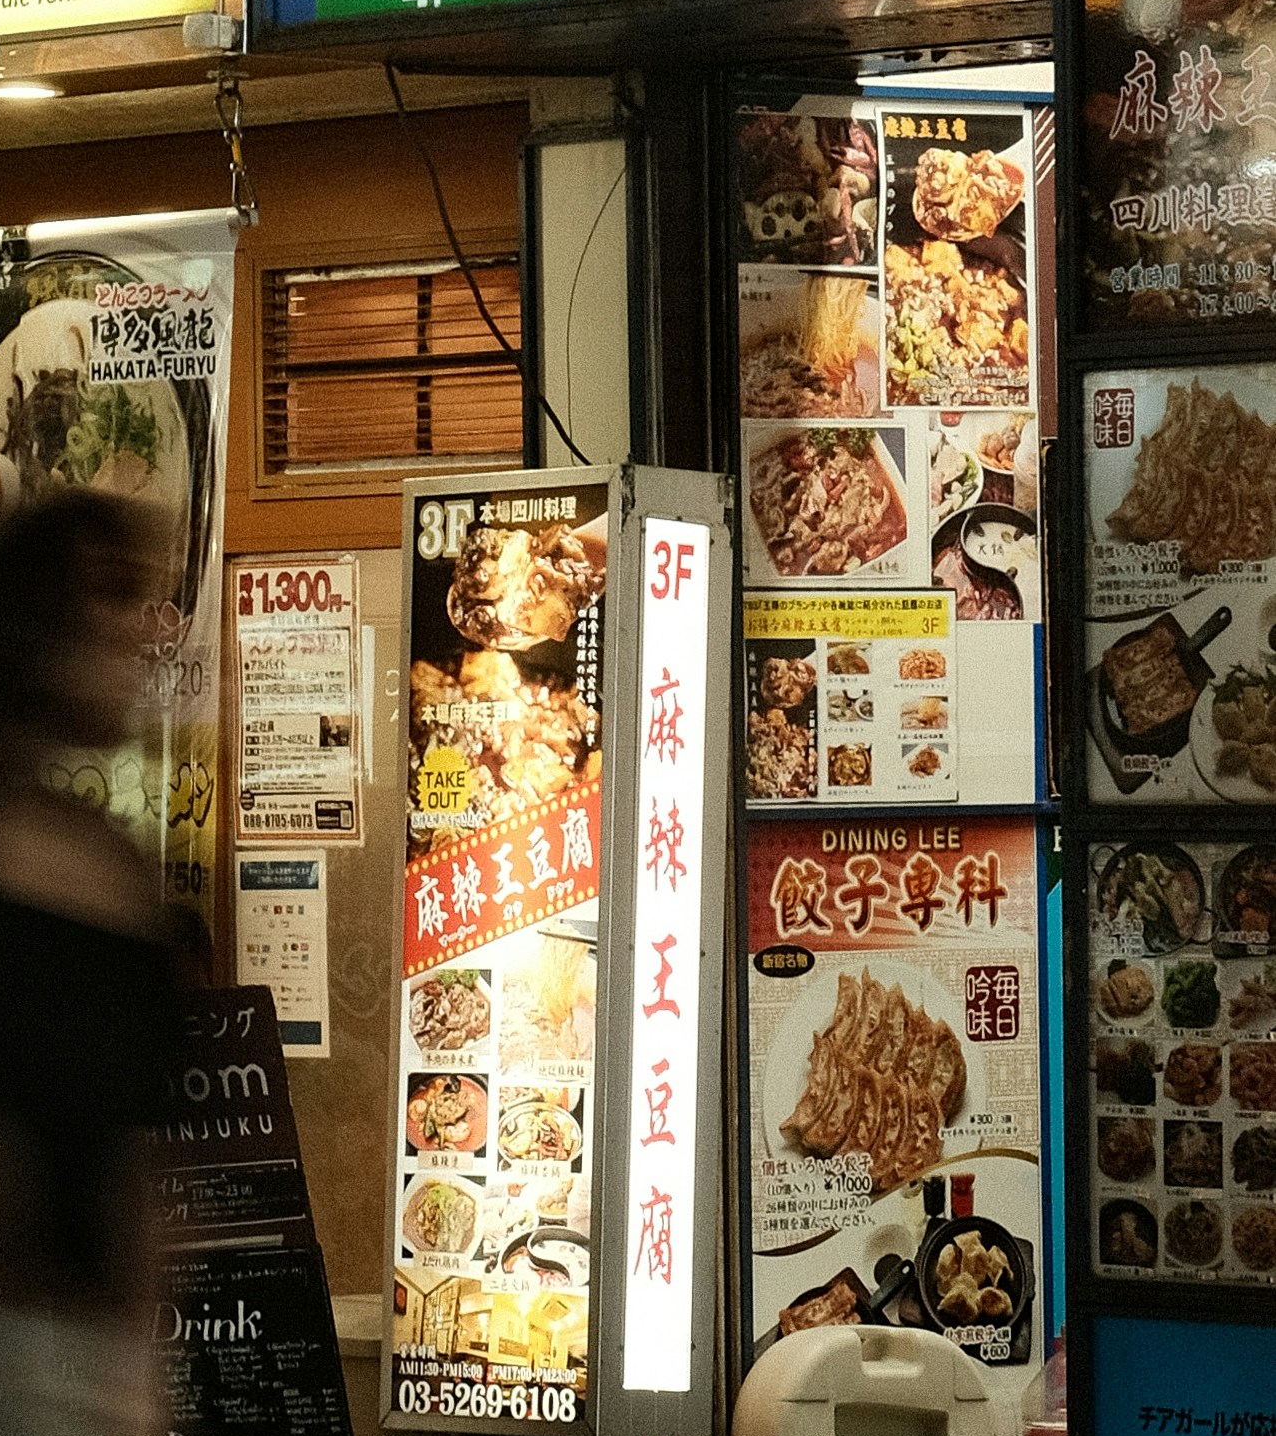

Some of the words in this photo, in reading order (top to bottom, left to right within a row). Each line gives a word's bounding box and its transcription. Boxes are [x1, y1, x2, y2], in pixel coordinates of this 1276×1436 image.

[89, 308, 216, 356] 博多風龍
[90, 354, 216, 382] HAKATA-FURYU
[416, 499, 475, 561] 3F
[478, 495, 578, 524] 本場四川料理
[649, 539, 695, 601] 3F
[921, 616, 940, 635] 3F
[423, 770, 466, 790] TAKE
[427, 792, 462, 810] OUT
[822, 827, 908, 854] DINING
[918, 826, 962, 851] LEE
[414, 806, 595, 942] 麻辣王豆腐
[770, 848, 1009, 938] 餃子専科
[633, 666, 689, 1286] 麻辣王豆腐
[760, 1154, 873, 1176] 個性いろいろ餃子
[153, 1298, 264, 1342] Drink
[398, 1380, 577, 1424] 03-5269-6108
